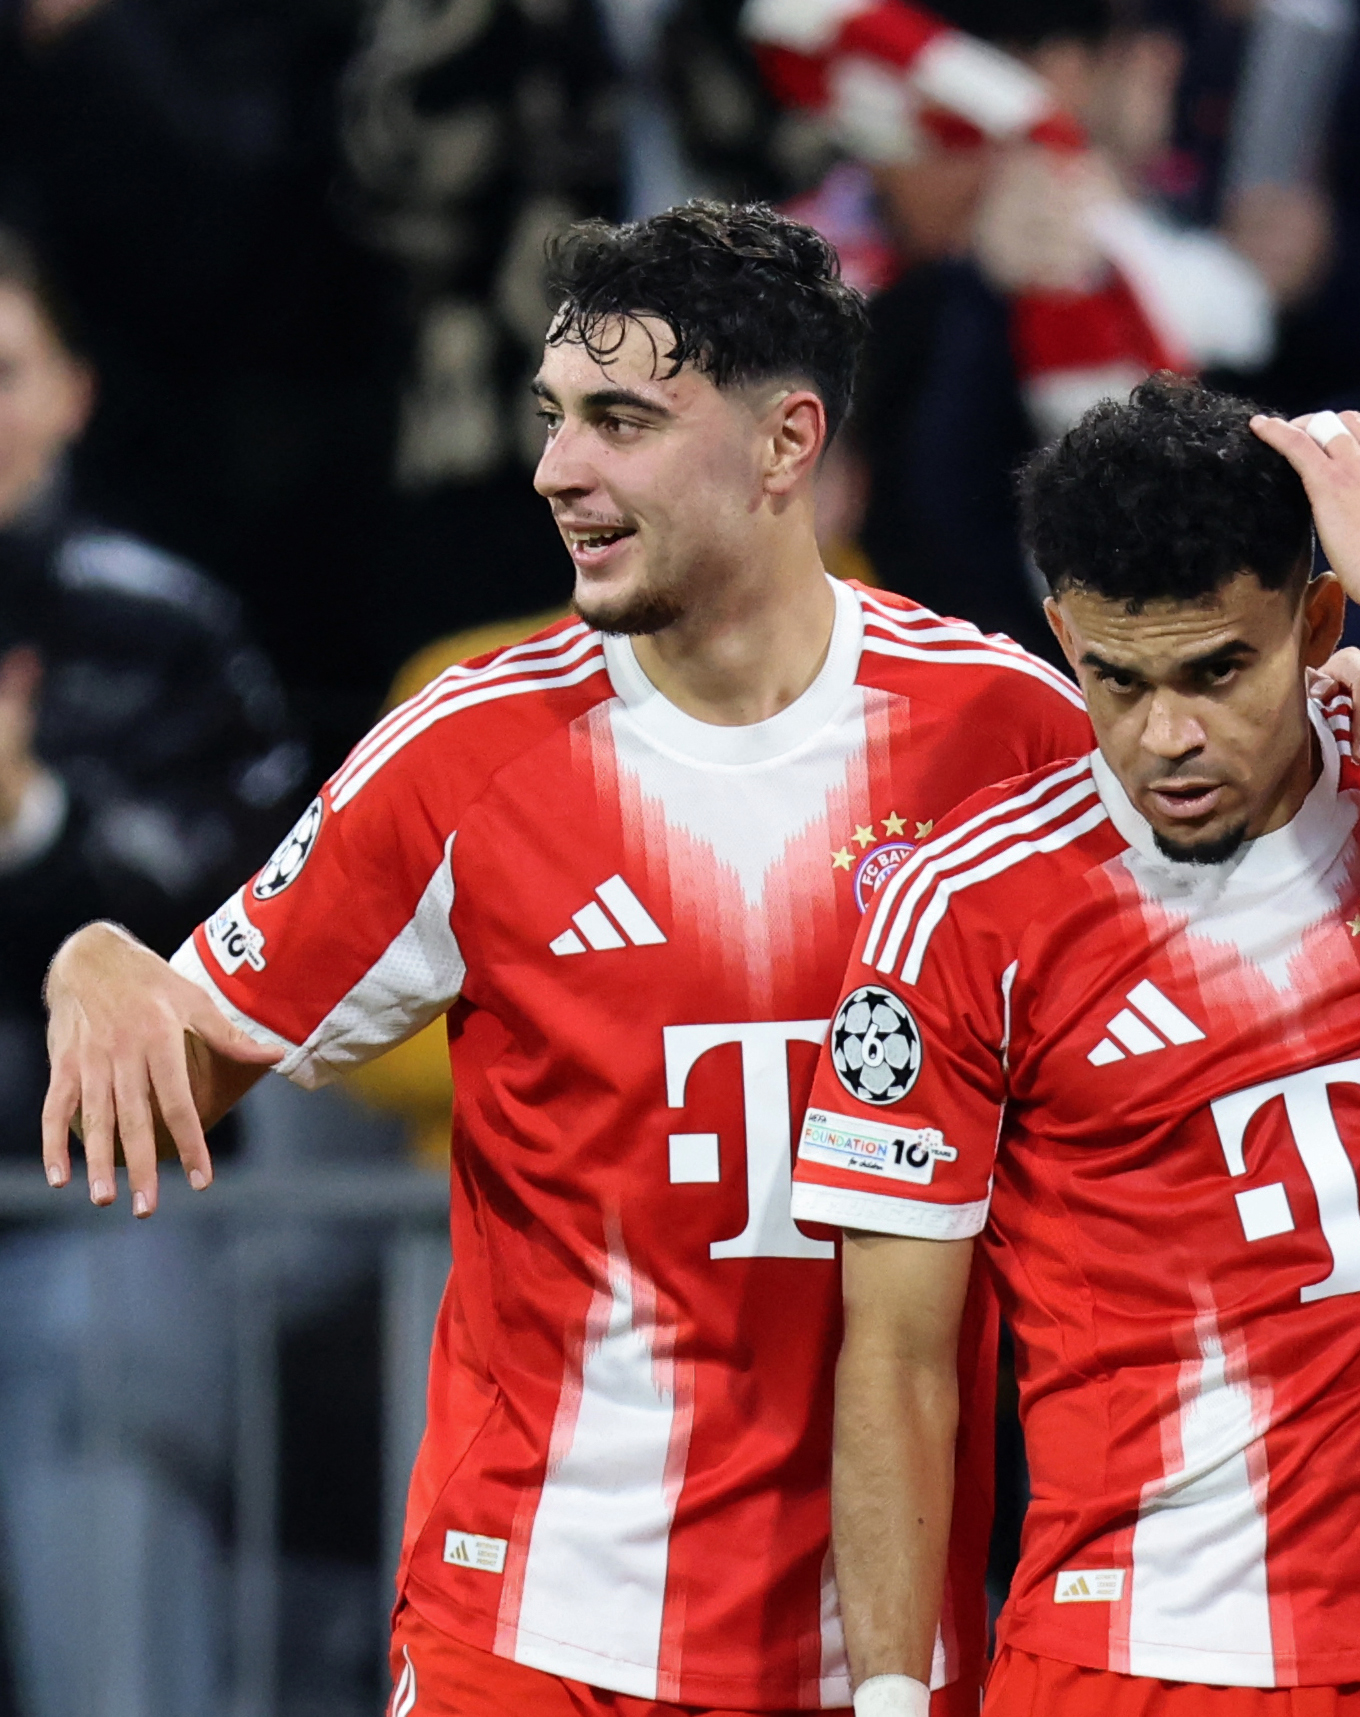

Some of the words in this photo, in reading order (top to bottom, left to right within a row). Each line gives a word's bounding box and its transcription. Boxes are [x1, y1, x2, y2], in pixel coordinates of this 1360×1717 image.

[862, 864, 879, 886] FC
[861, 1022, 885, 1068] 6
[808, 1112, 828, 1124] UEFA
[663, 1019, 835, 1260] T
[892, 1138, 930, 1168] 10
